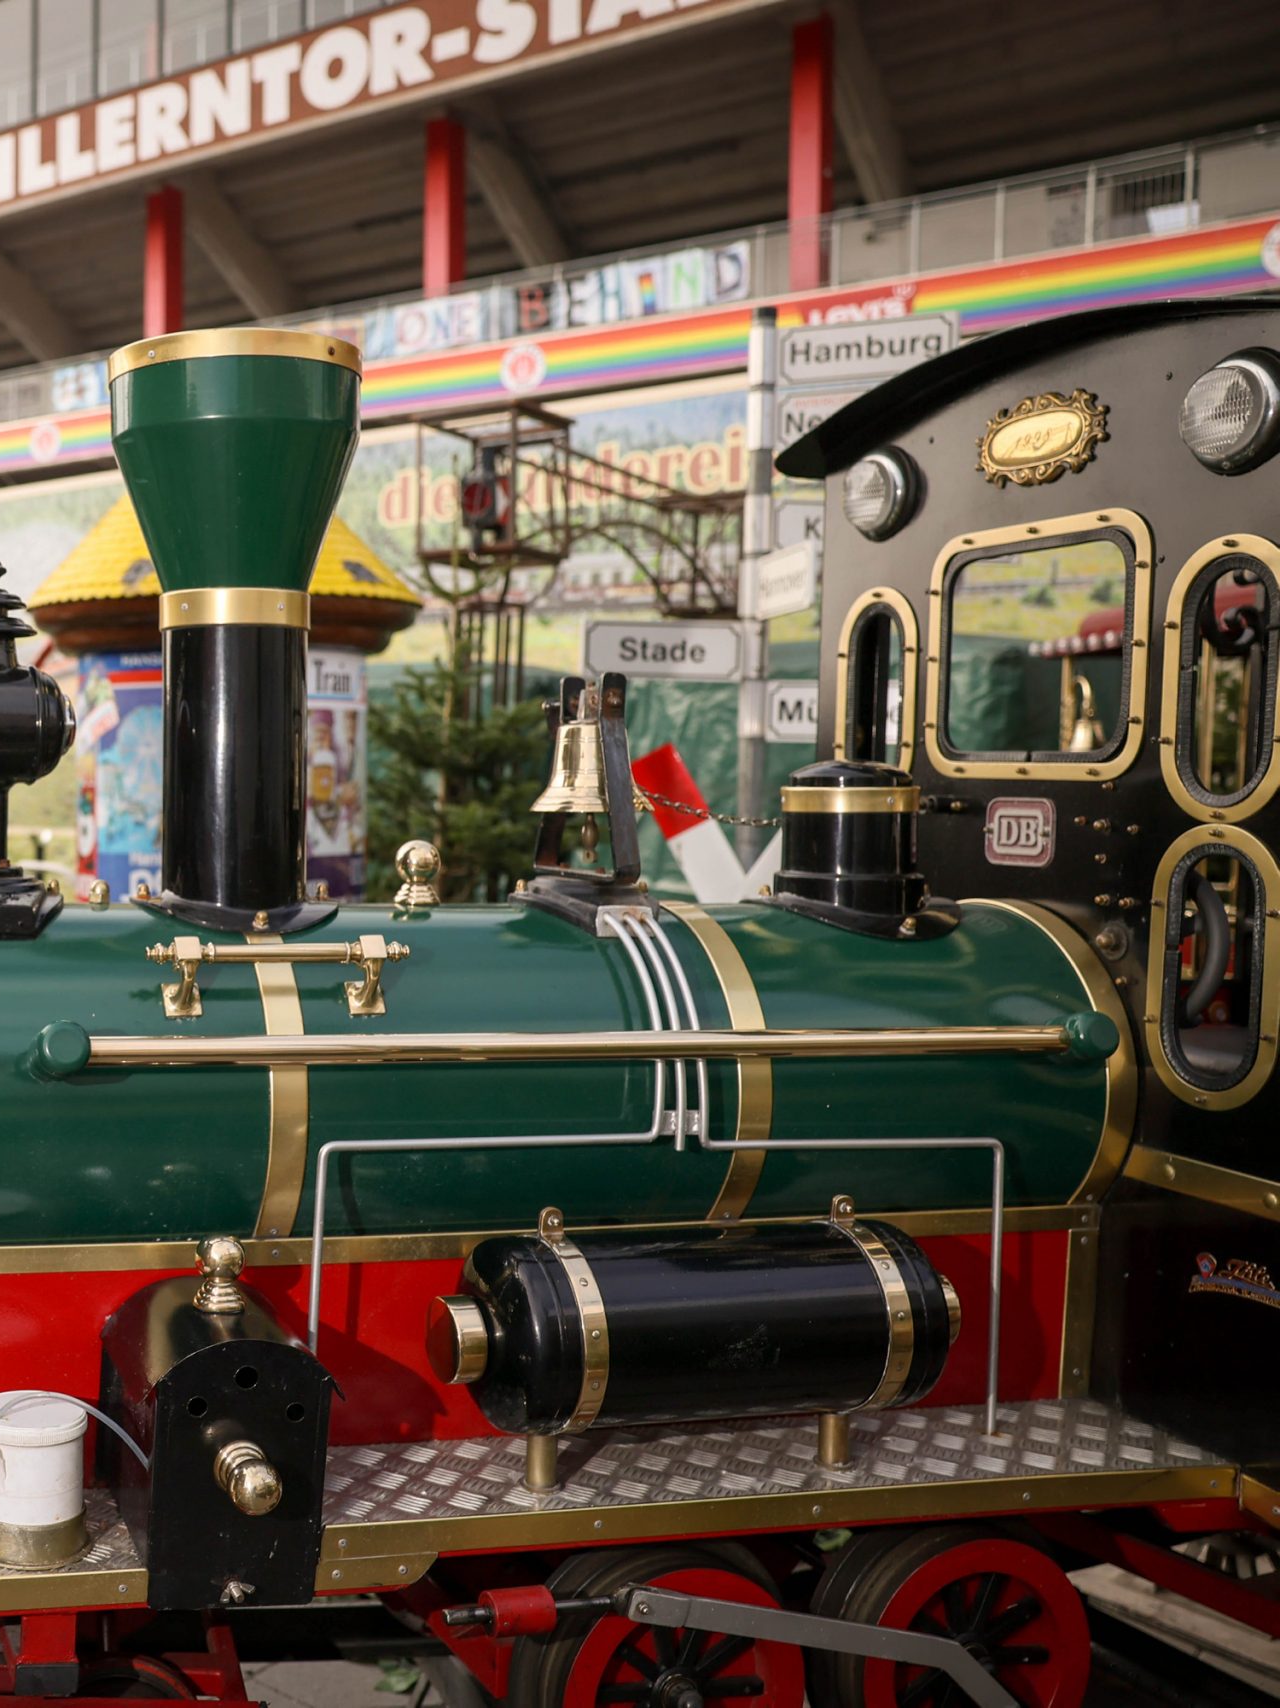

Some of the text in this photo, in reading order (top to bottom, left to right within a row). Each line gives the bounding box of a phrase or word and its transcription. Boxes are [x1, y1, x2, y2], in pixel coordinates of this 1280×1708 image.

[790, 333, 942, 365] Hamburg
[619, 637, 706, 663] Stade
[999, 816, 1038, 846] DB
